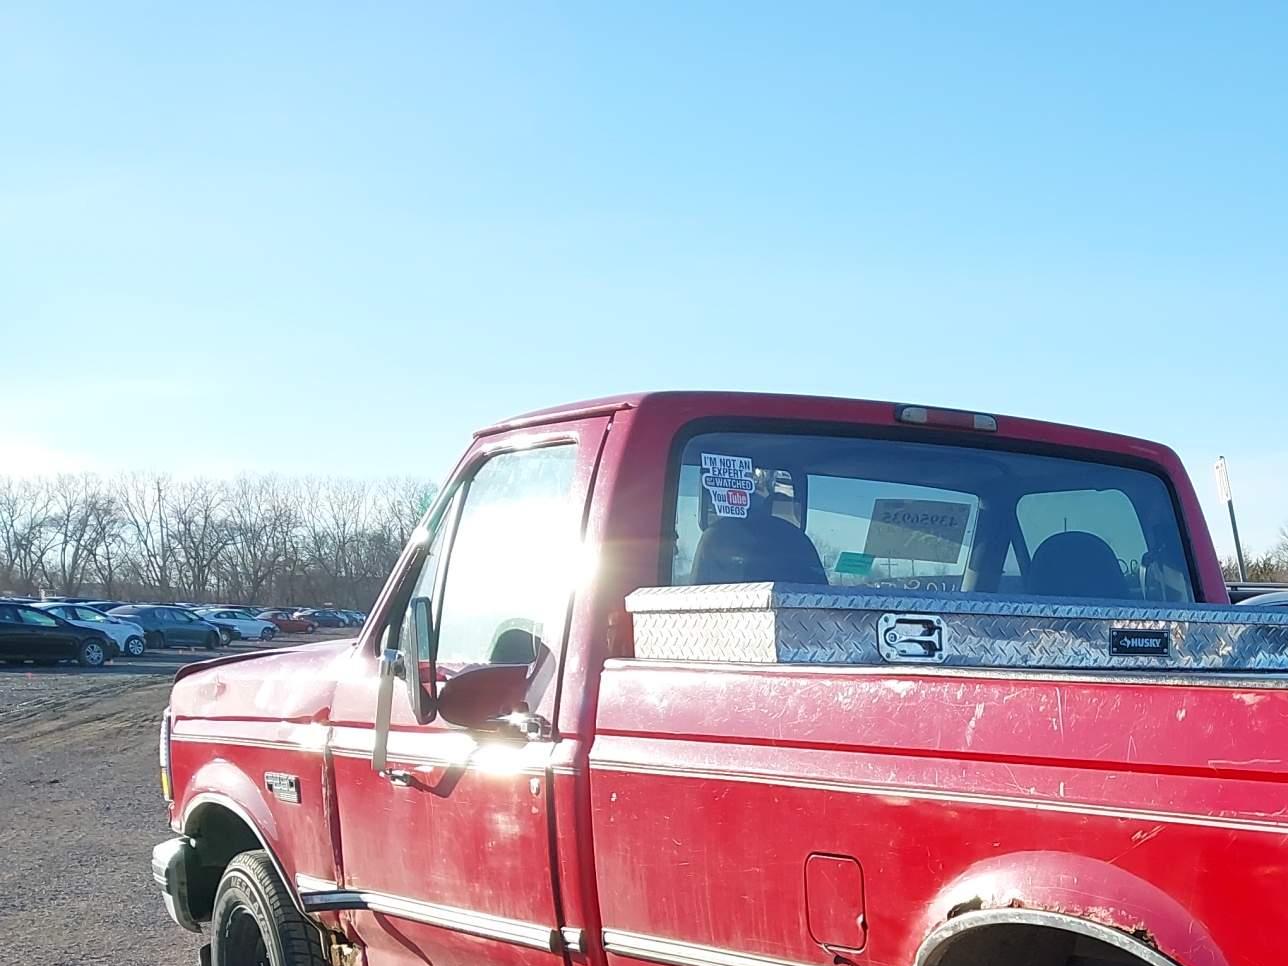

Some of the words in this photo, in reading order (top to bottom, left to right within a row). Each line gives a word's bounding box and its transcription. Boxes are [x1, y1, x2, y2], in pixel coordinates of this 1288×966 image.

[703, 455, 717, 467] I'M
[719, 457, 737, 469] NOT
[738, 459, 751, 471] AN
[711, 466, 744, 478] EXPERT
[715, 478, 752, 489] WATCHED
[717, 505, 745, 516] VIDEOS
[1131, 637, 1162, 648] HUSKY
